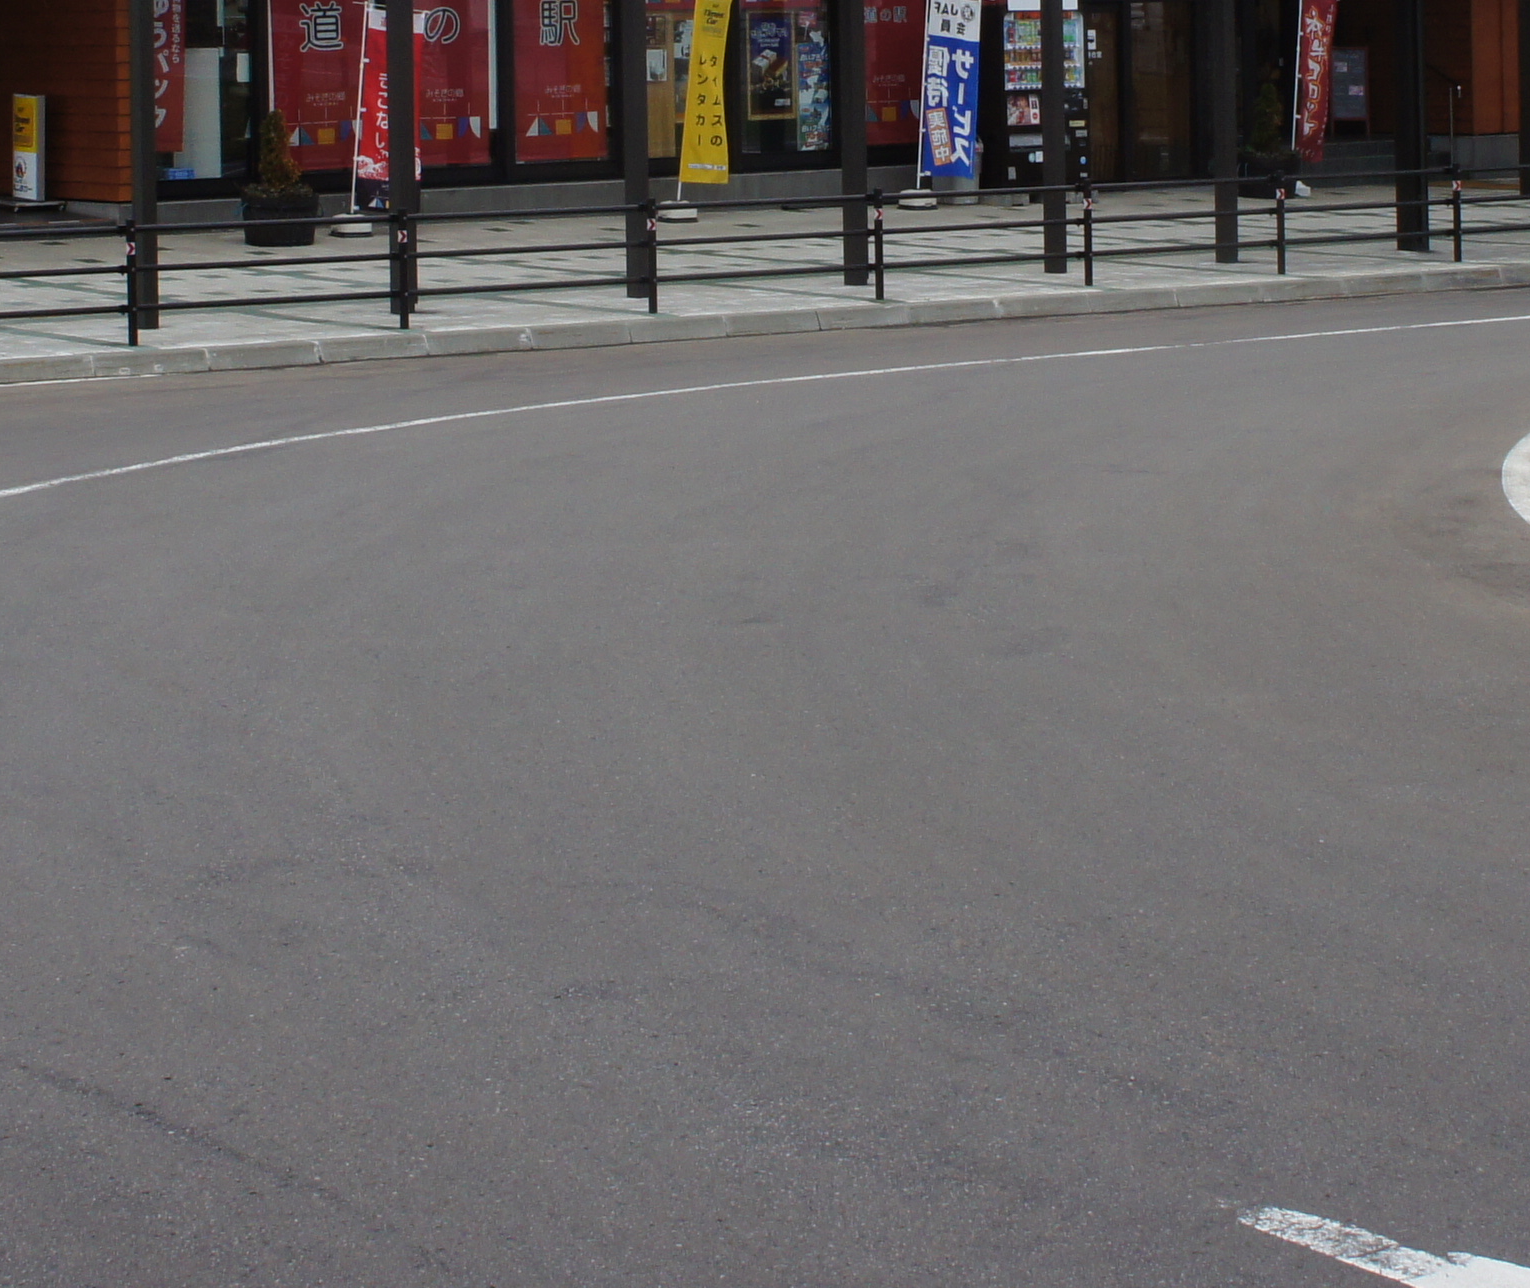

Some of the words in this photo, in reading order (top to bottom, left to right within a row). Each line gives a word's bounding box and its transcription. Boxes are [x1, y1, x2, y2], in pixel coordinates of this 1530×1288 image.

[696, 55, 708, 146] レンタカー
